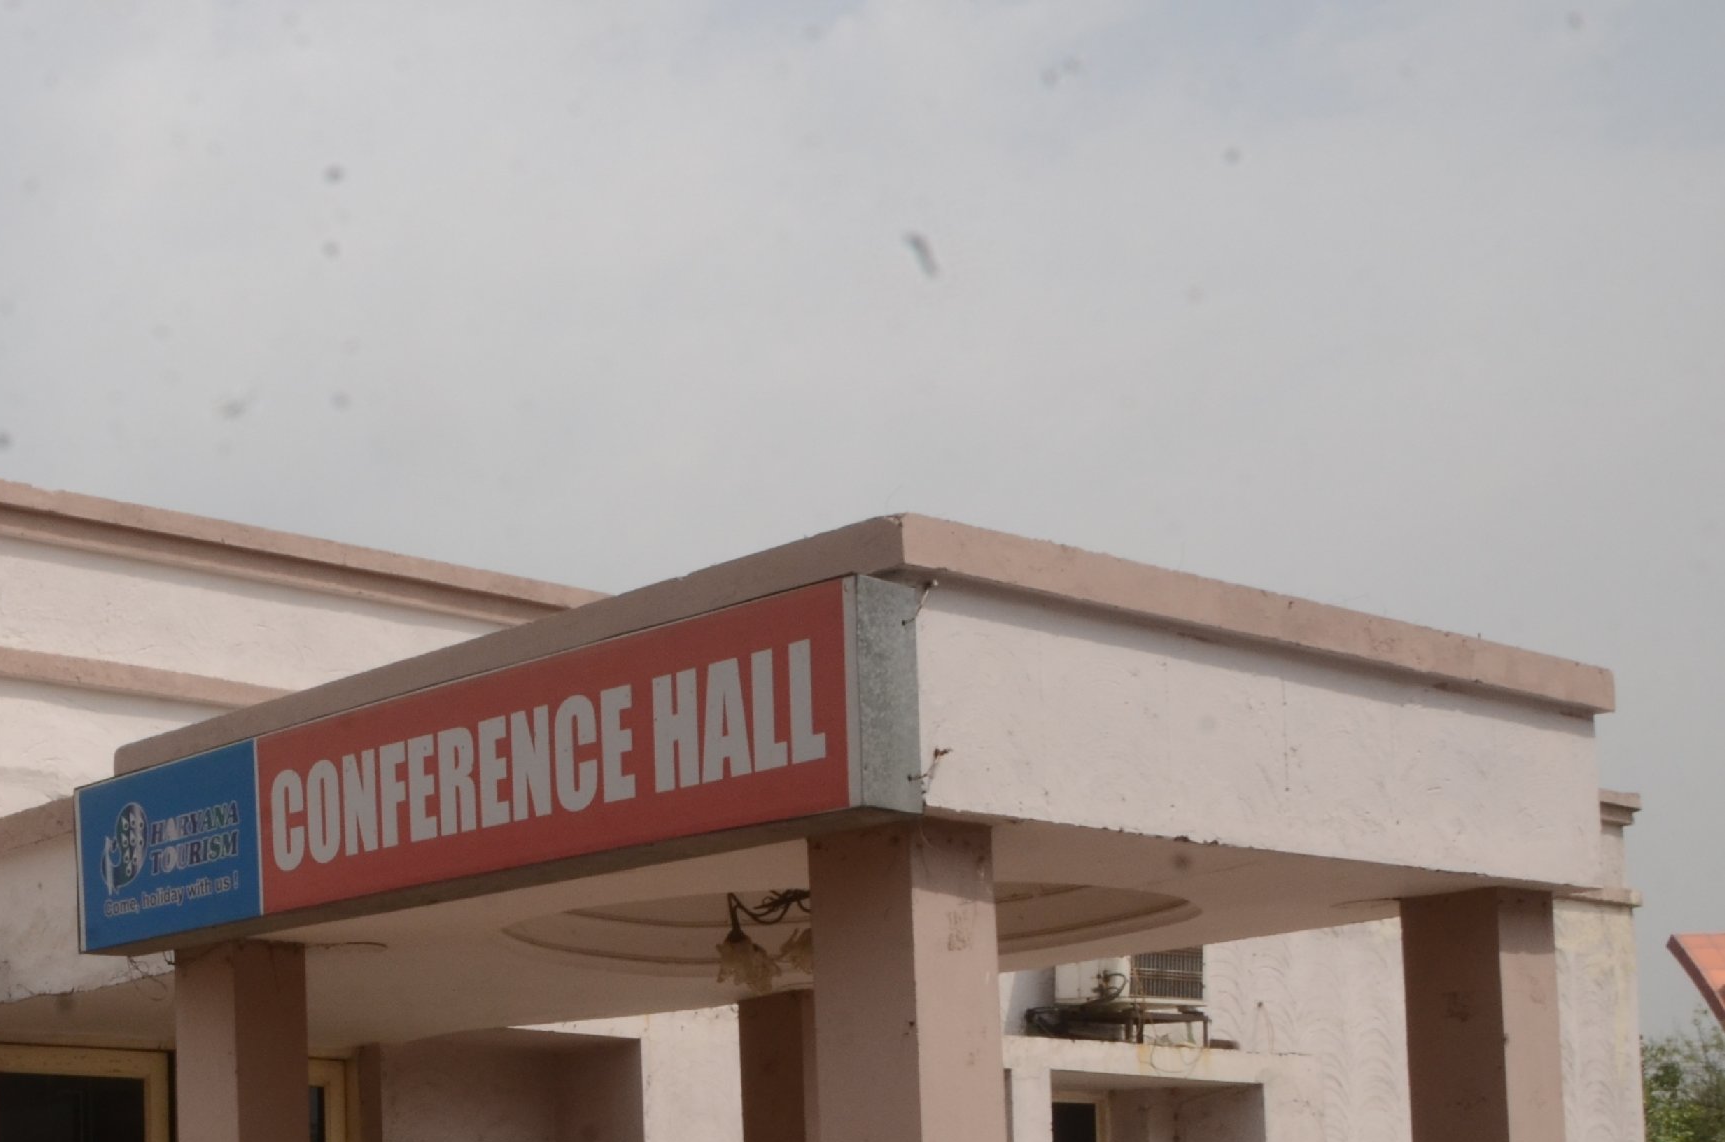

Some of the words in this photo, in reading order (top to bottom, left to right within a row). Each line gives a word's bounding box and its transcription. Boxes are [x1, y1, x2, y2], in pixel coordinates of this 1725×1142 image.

[271, 684, 636, 871] CONFERENCE
[652, 639, 827, 793] HALL
[149, 800, 240, 847] HARYANA
[149, 829, 240, 876] TOURISM
[104, 897, 140, 917] Come,
[141, 886, 185, 909] holiday
[186, 876, 214, 900] with
